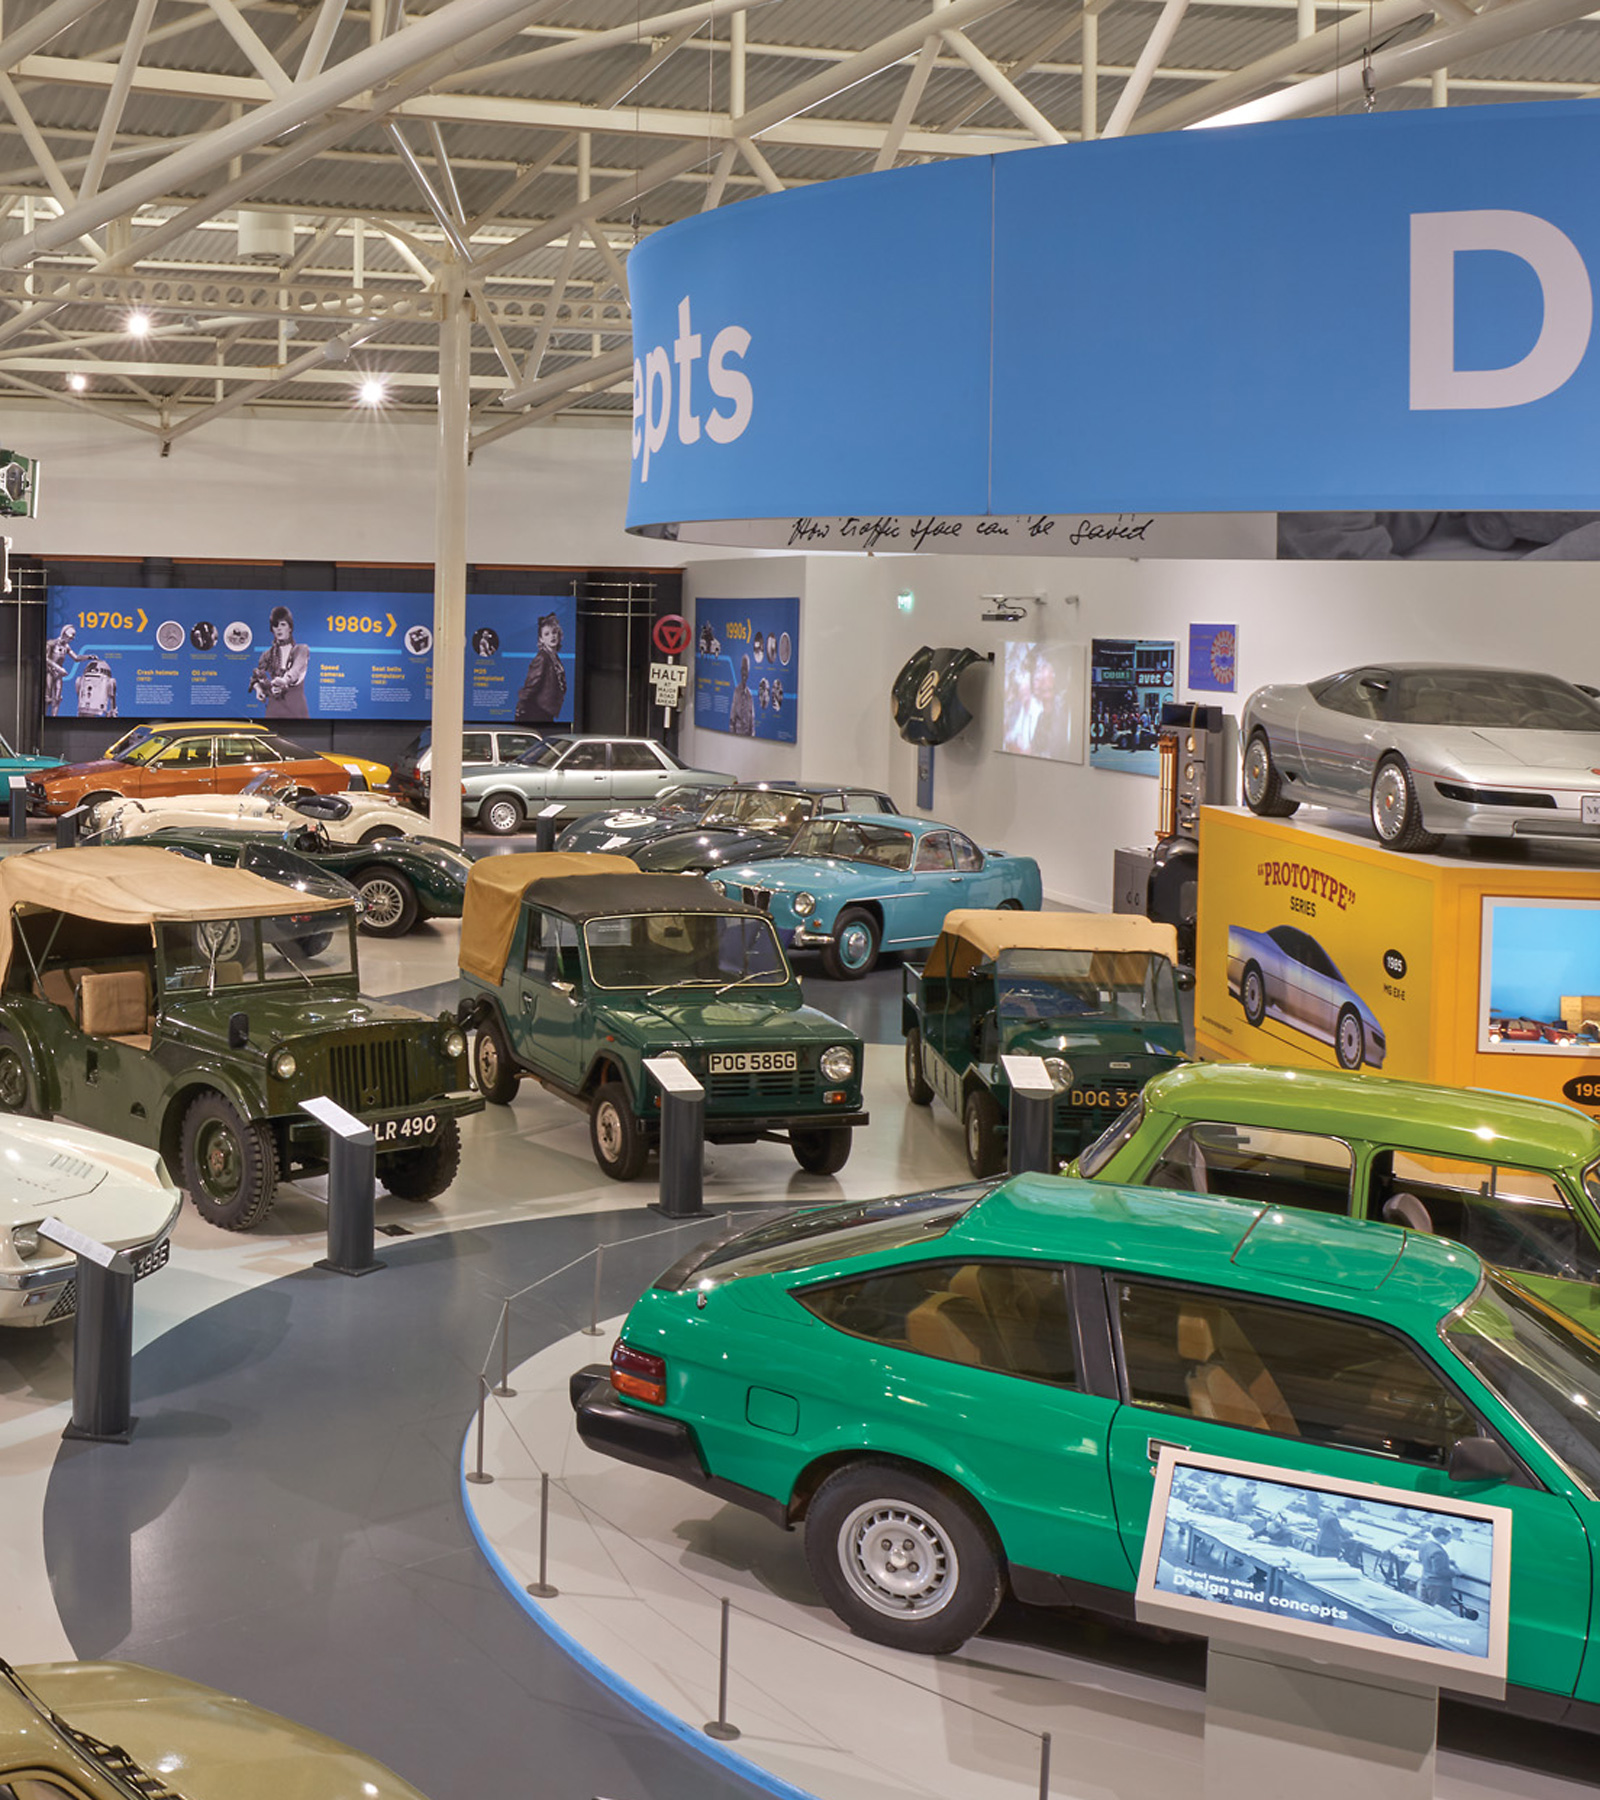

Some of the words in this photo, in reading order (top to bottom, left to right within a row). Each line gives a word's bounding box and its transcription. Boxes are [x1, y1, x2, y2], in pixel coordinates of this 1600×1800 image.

[1409, 209, 1594, 411] D
[78, 612, 134, 629] 1970s
[326, 615, 383, 633] 1980s
[726, 622, 747, 640] 1990s
[651, 668, 685, 681] HALT
[1138, 674, 1161, 684] avec
[1290, 896, 1317, 918] SERIES
[1386, 956, 1403, 972] 1985
[711, 1055, 746, 1071] POG
[750, 1053, 795, 1071] 586G
[1071, 1091, 1111, 1107] DOG
[370, 1123, 397, 1141] LR
[400, 1115, 437, 1137] 490
[1193, 1571, 1207, 1579] out
[1208, 1574, 1230, 1584] more
[1230, 1578, 1255, 1589] about
[1173, 1574, 1229, 1596] Design
[1233, 1588, 1264, 1603] and
[1269, 1595, 1348, 1620] concepts
